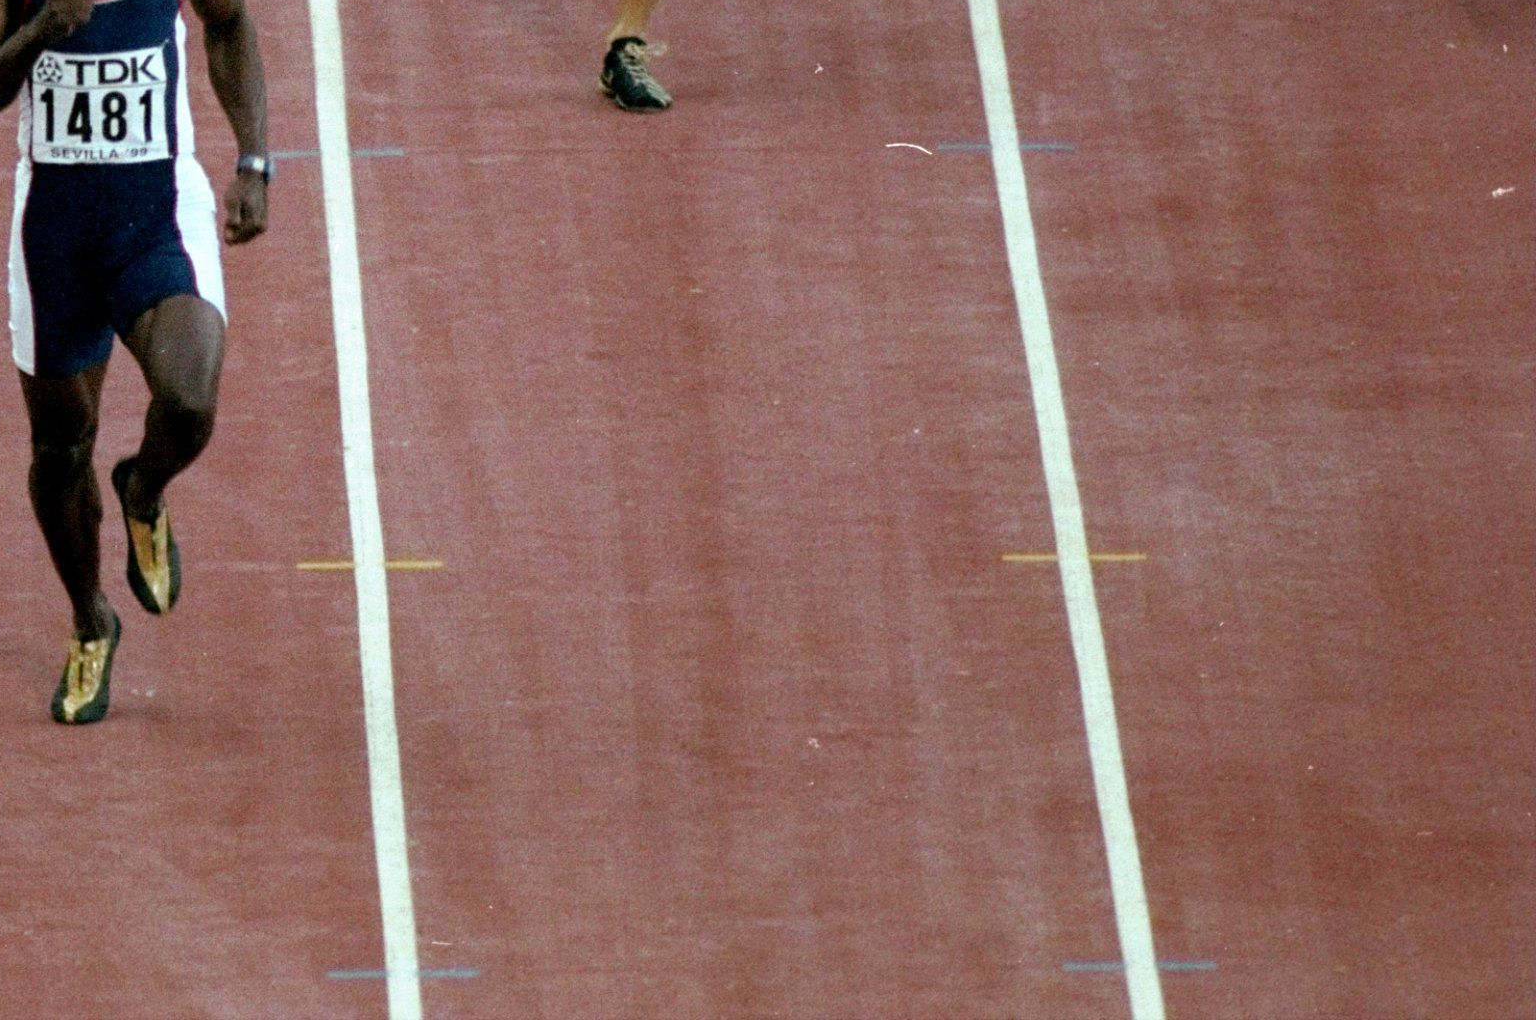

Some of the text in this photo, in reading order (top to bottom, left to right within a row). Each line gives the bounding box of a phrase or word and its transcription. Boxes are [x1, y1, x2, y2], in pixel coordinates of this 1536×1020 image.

[65, 54, 159, 85] TDK
[40, 88, 153, 144] 1481
[50, 147, 120, 160] SEVILLA
